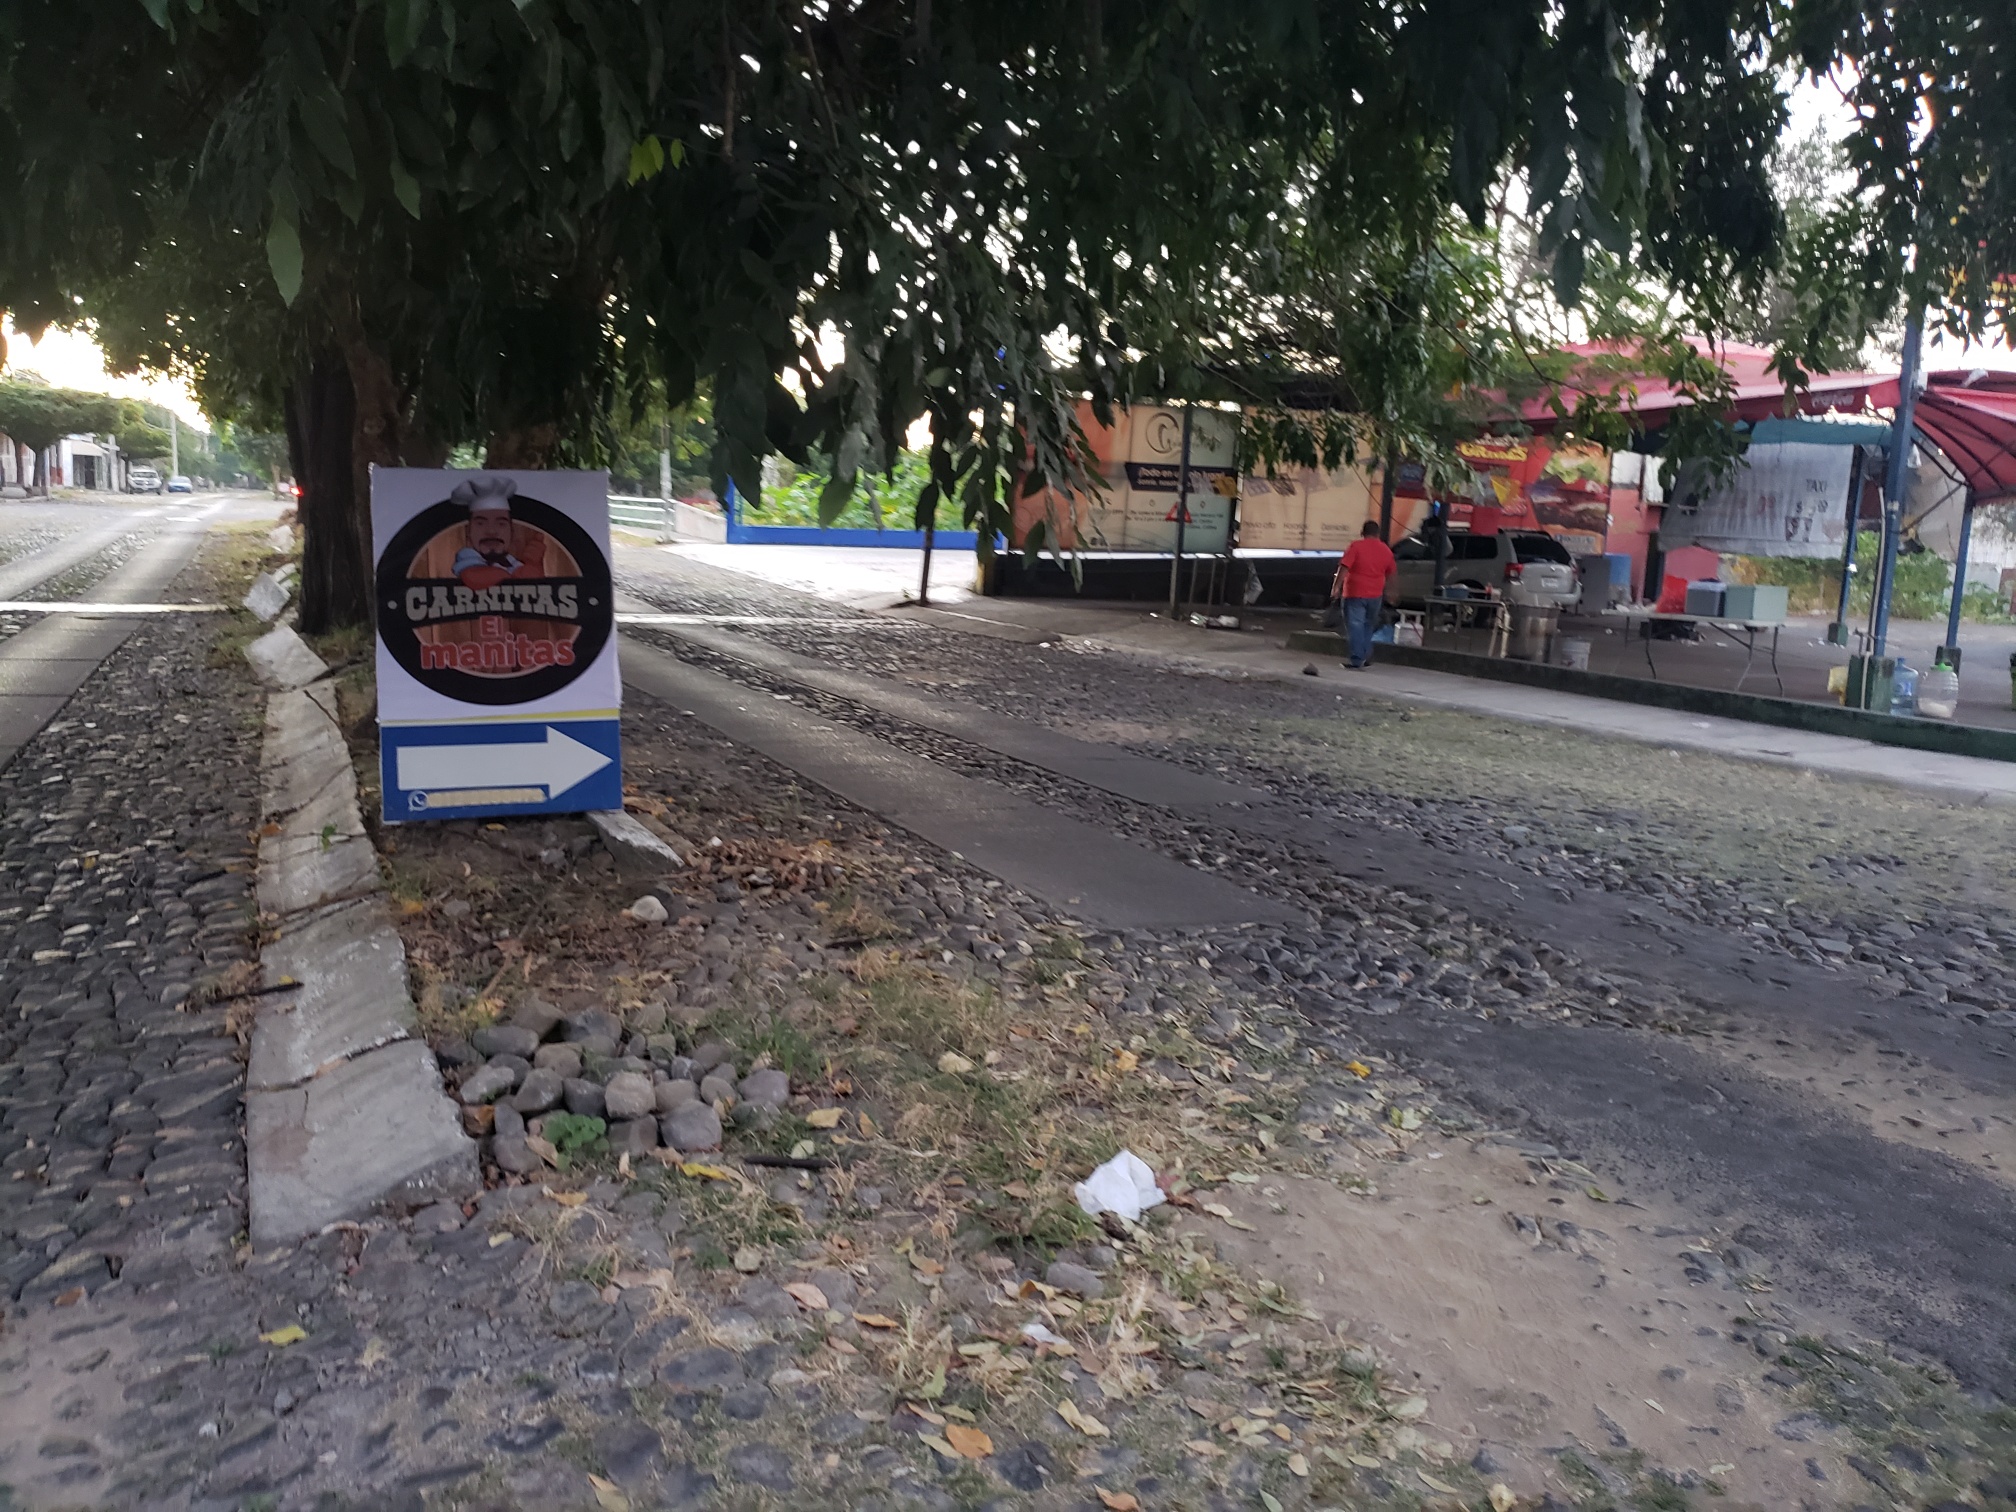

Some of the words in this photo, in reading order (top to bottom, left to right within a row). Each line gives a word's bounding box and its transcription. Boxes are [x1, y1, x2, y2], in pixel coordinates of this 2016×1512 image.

[406, 585, 579, 621] CARNITAS
[479, 615, 505, 638] El
[420, 632, 575, 669] manitas
